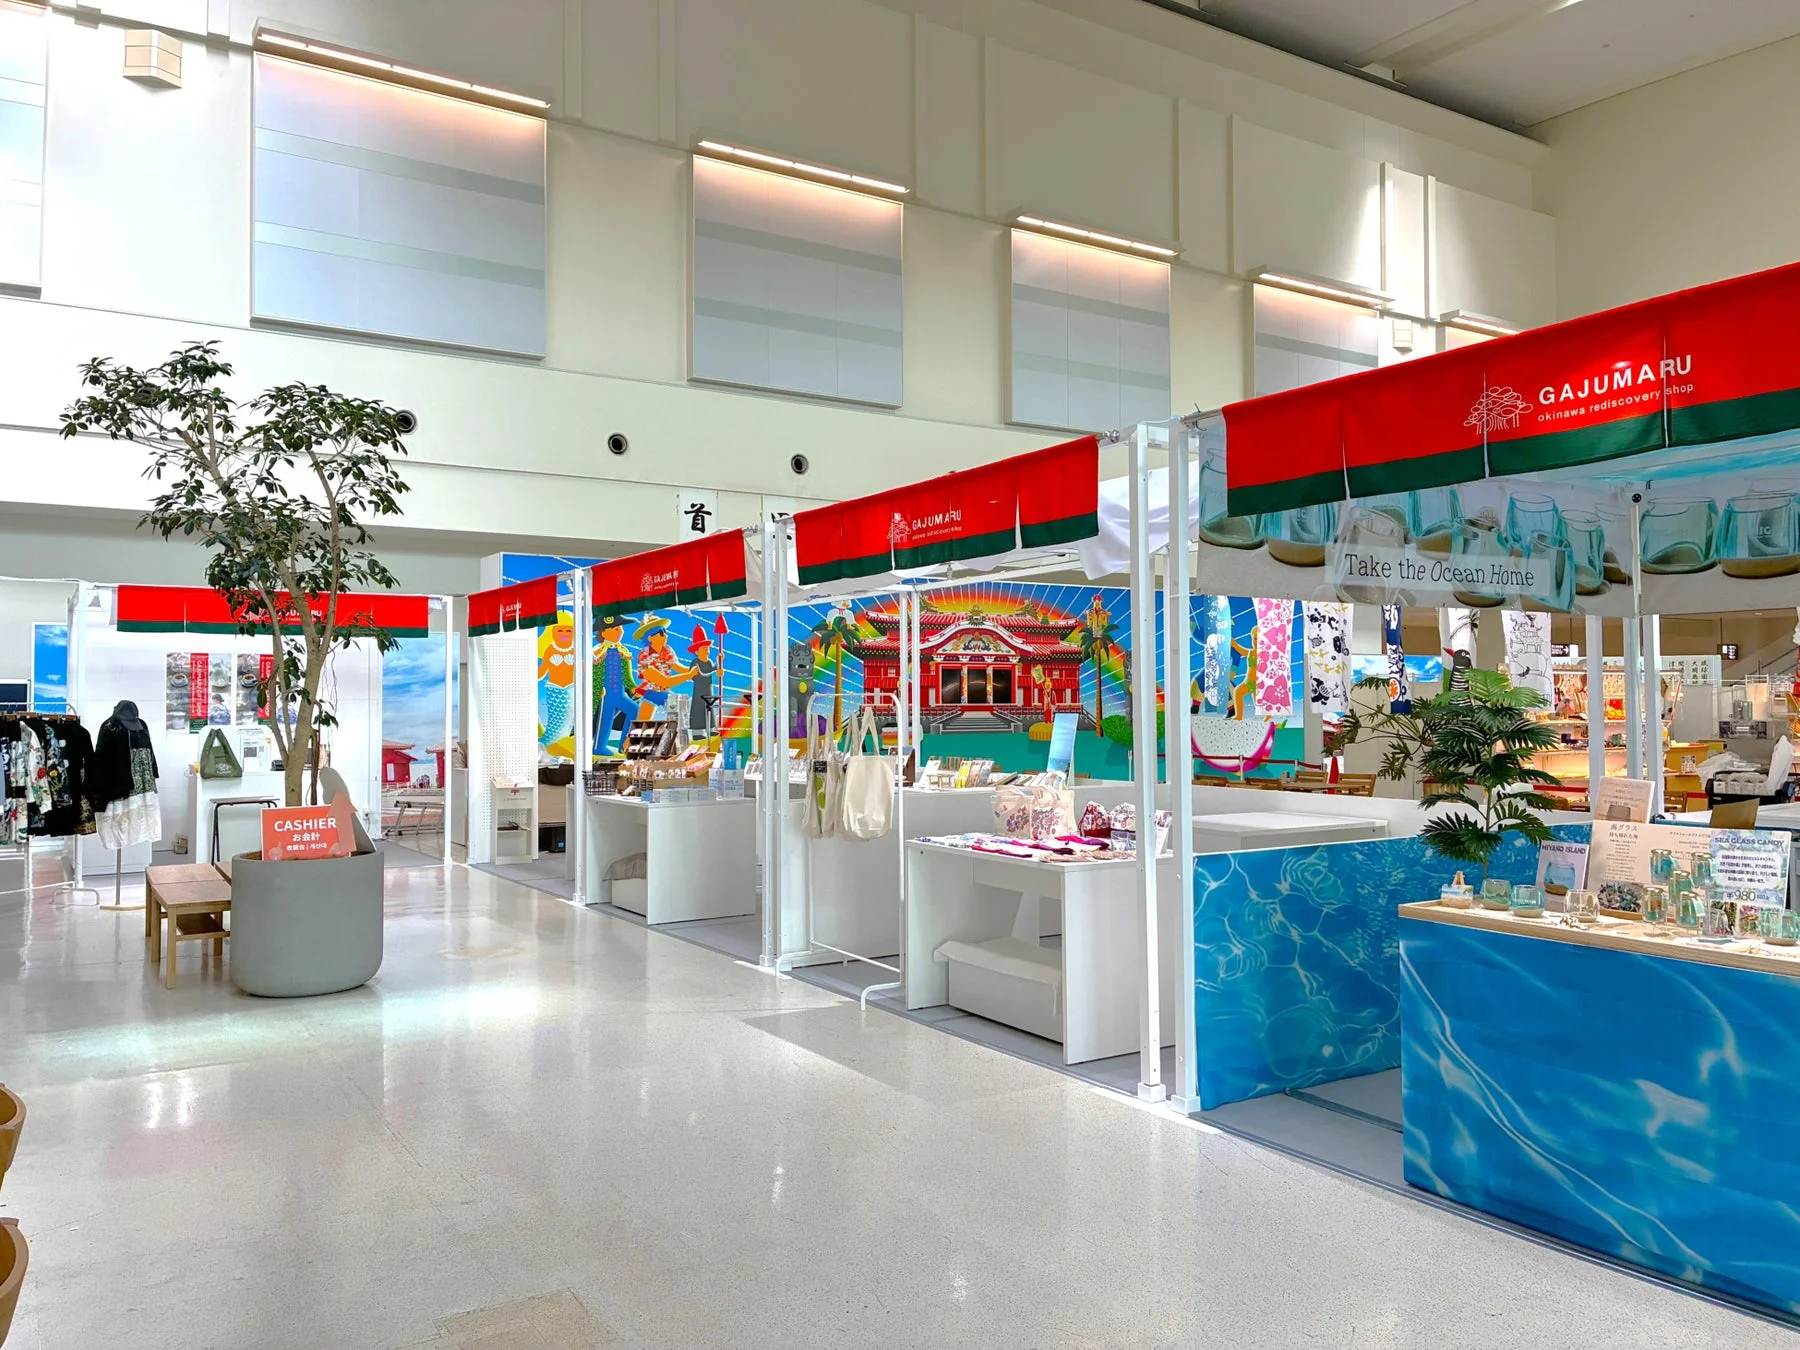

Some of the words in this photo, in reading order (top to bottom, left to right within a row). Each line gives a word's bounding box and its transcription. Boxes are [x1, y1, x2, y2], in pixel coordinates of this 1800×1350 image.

[1538, 354, 1692, 405] GAJUMARU
[1537, 407, 1586, 422] okinawa
[1589, 390, 1661, 412] rediscovery
[1665, 383, 1694, 396] shop
[683, 502, 713, 534] 首
[912, 509, 962, 531] GAJUMARU
[1344, 553, 1392, 578] Take
[1398, 558, 1426, 581] the
[1430, 560, 1485, 584] Ocean
[1489, 564, 1534, 586] Home
[274, 817, 337, 832] CASHIER
[292, 832, 320, 842] お会計
[1757, 839, 1785, 847] CANDY
[1541, 844, 1564, 852] MIYAKO
[1565, 846, 1586, 854] ISLAND
[1734, 889, 1756, 901] 980
